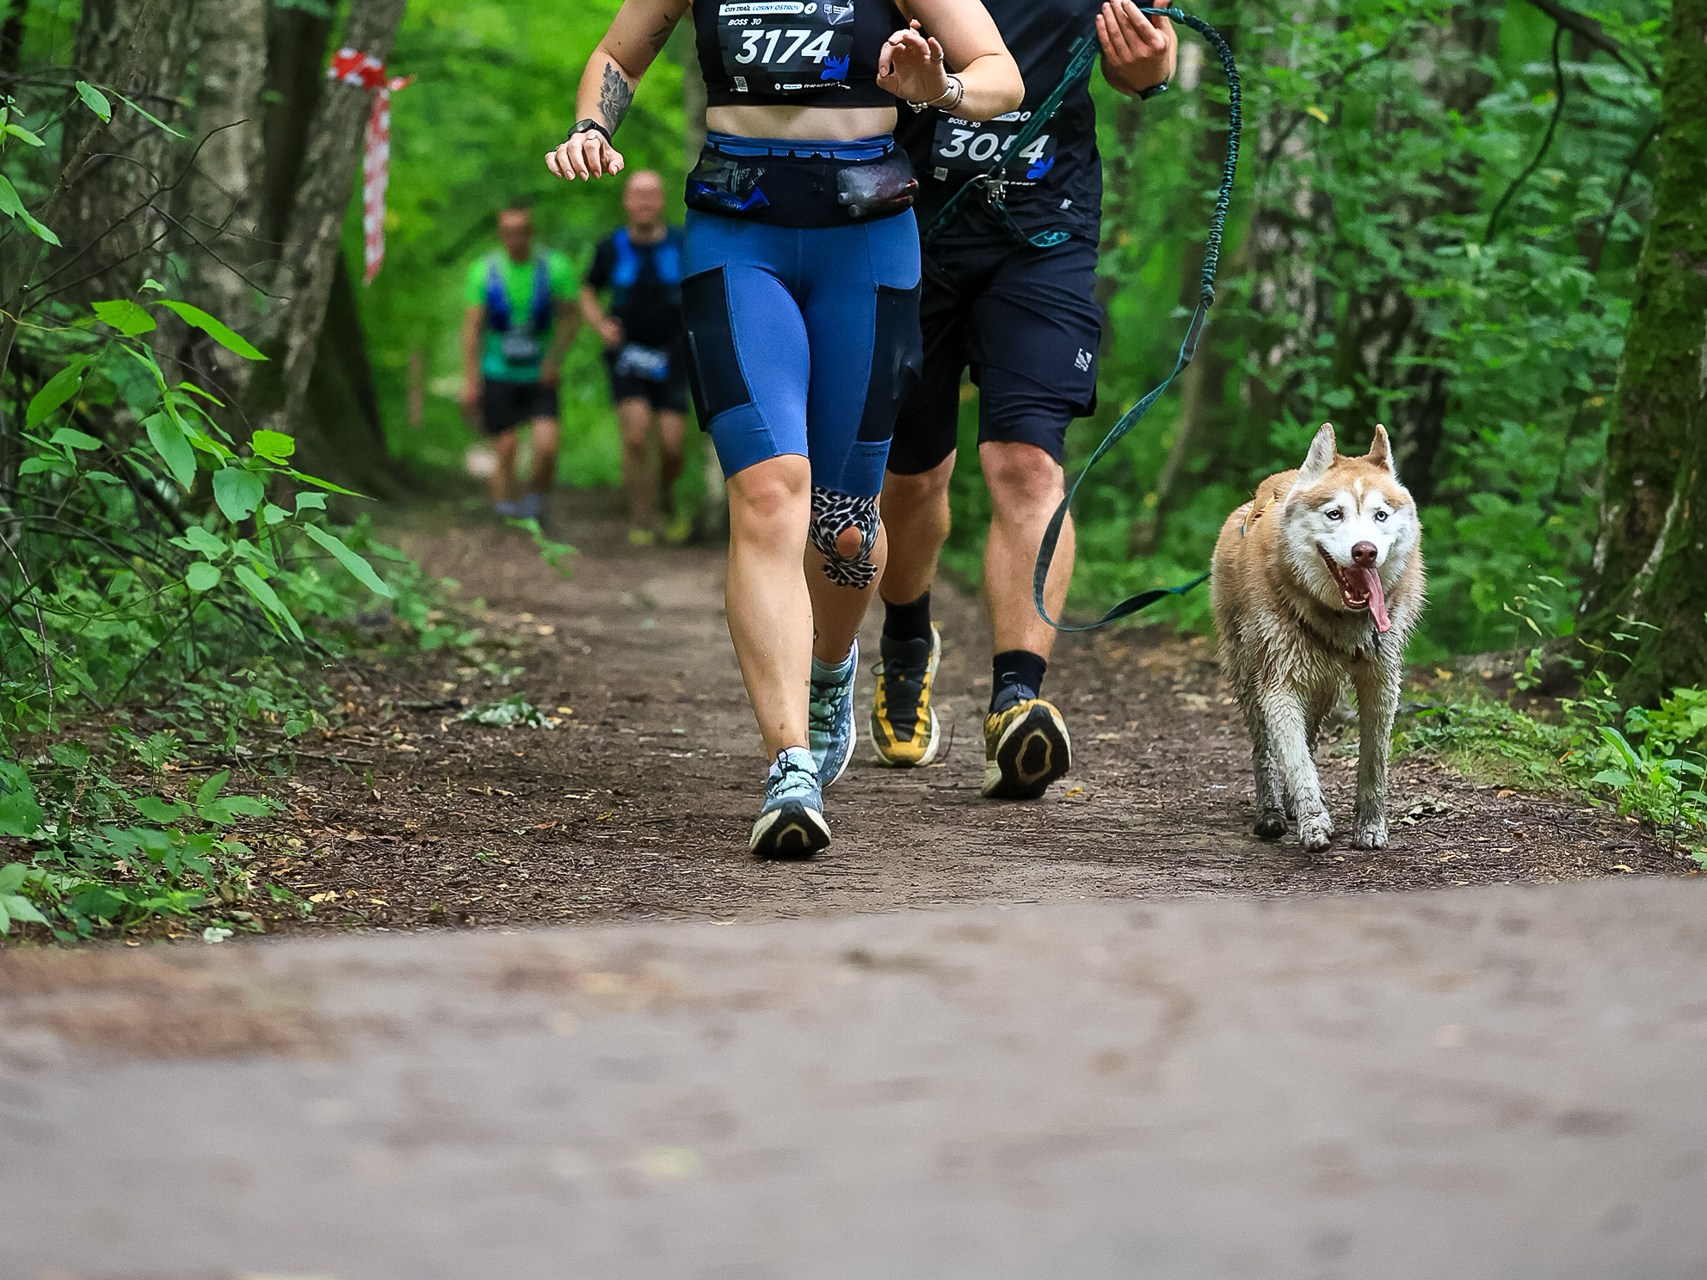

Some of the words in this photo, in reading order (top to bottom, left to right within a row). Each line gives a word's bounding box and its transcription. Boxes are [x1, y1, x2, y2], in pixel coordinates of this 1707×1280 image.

[727, 18, 748, 26] BOSS
[734, 29, 835, 64] 3174
[947, 117, 968, 126] BOSS
